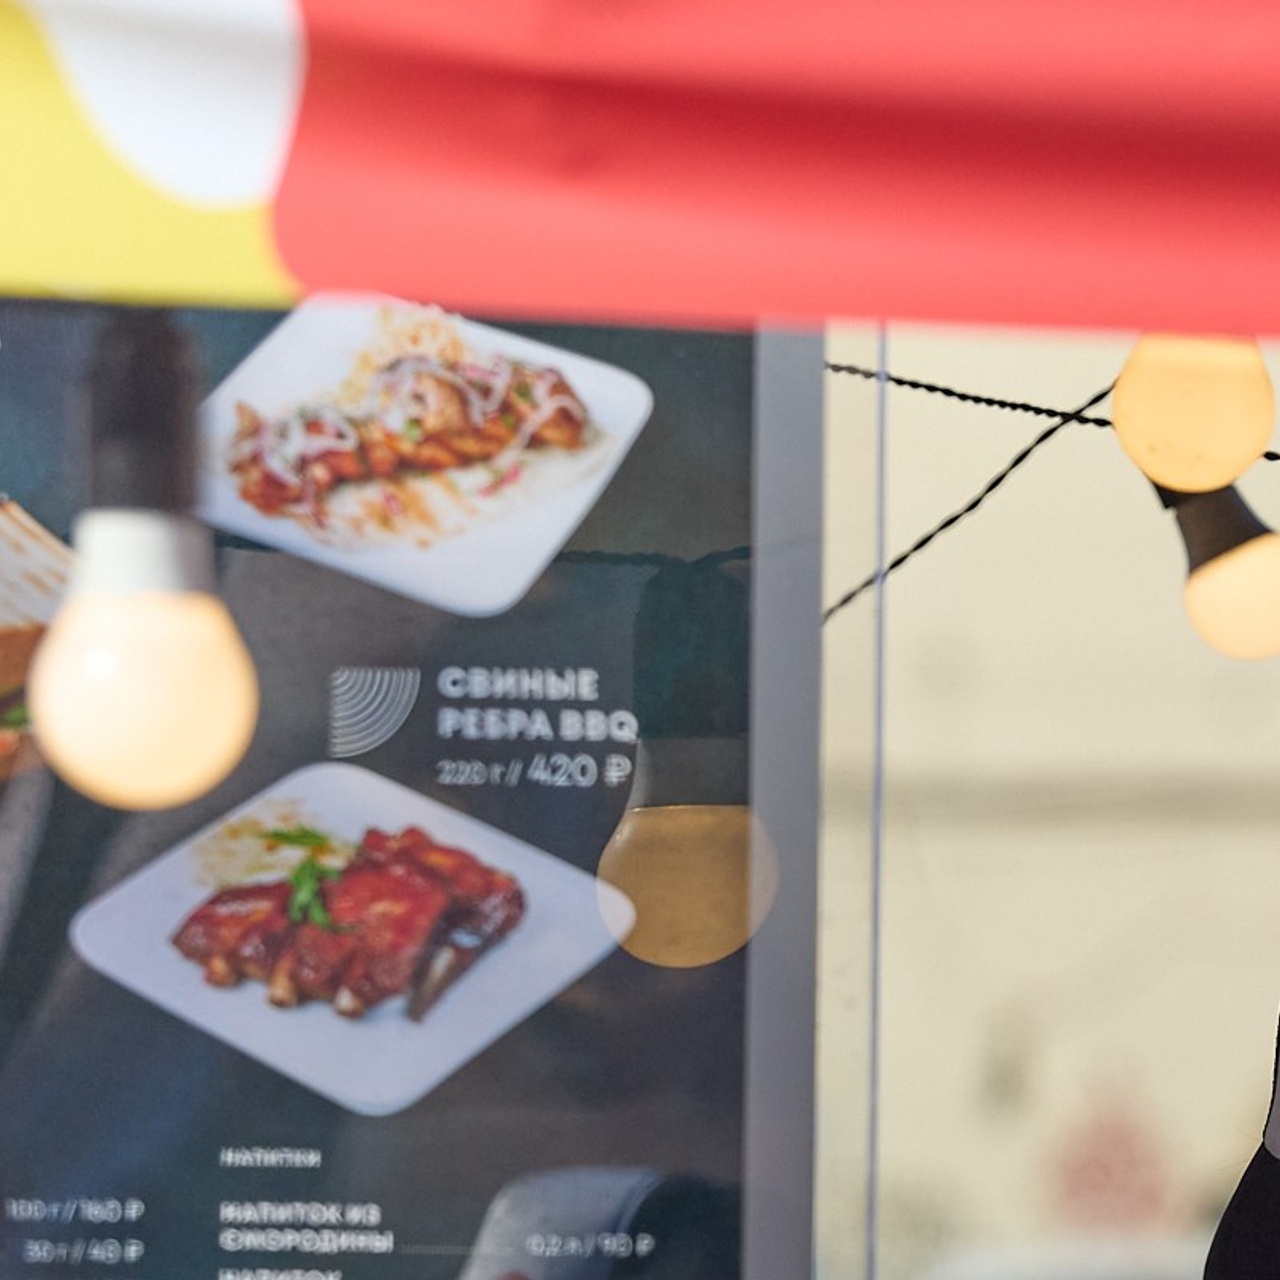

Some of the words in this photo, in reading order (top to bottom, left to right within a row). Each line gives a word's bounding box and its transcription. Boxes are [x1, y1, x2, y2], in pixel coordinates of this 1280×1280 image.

[437, 666, 599, 700] СВИНЫЕ
[437, 707, 553, 740] РЕБРА
[559, 709, 639, 743] BBQ
[436, 759, 488, 785] 220
[527, 753, 598, 787] 420
[219, 1202, 343, 1224] НАПИТОК
[219, 1228, 394, 1253] СМОРОДИНЫ
